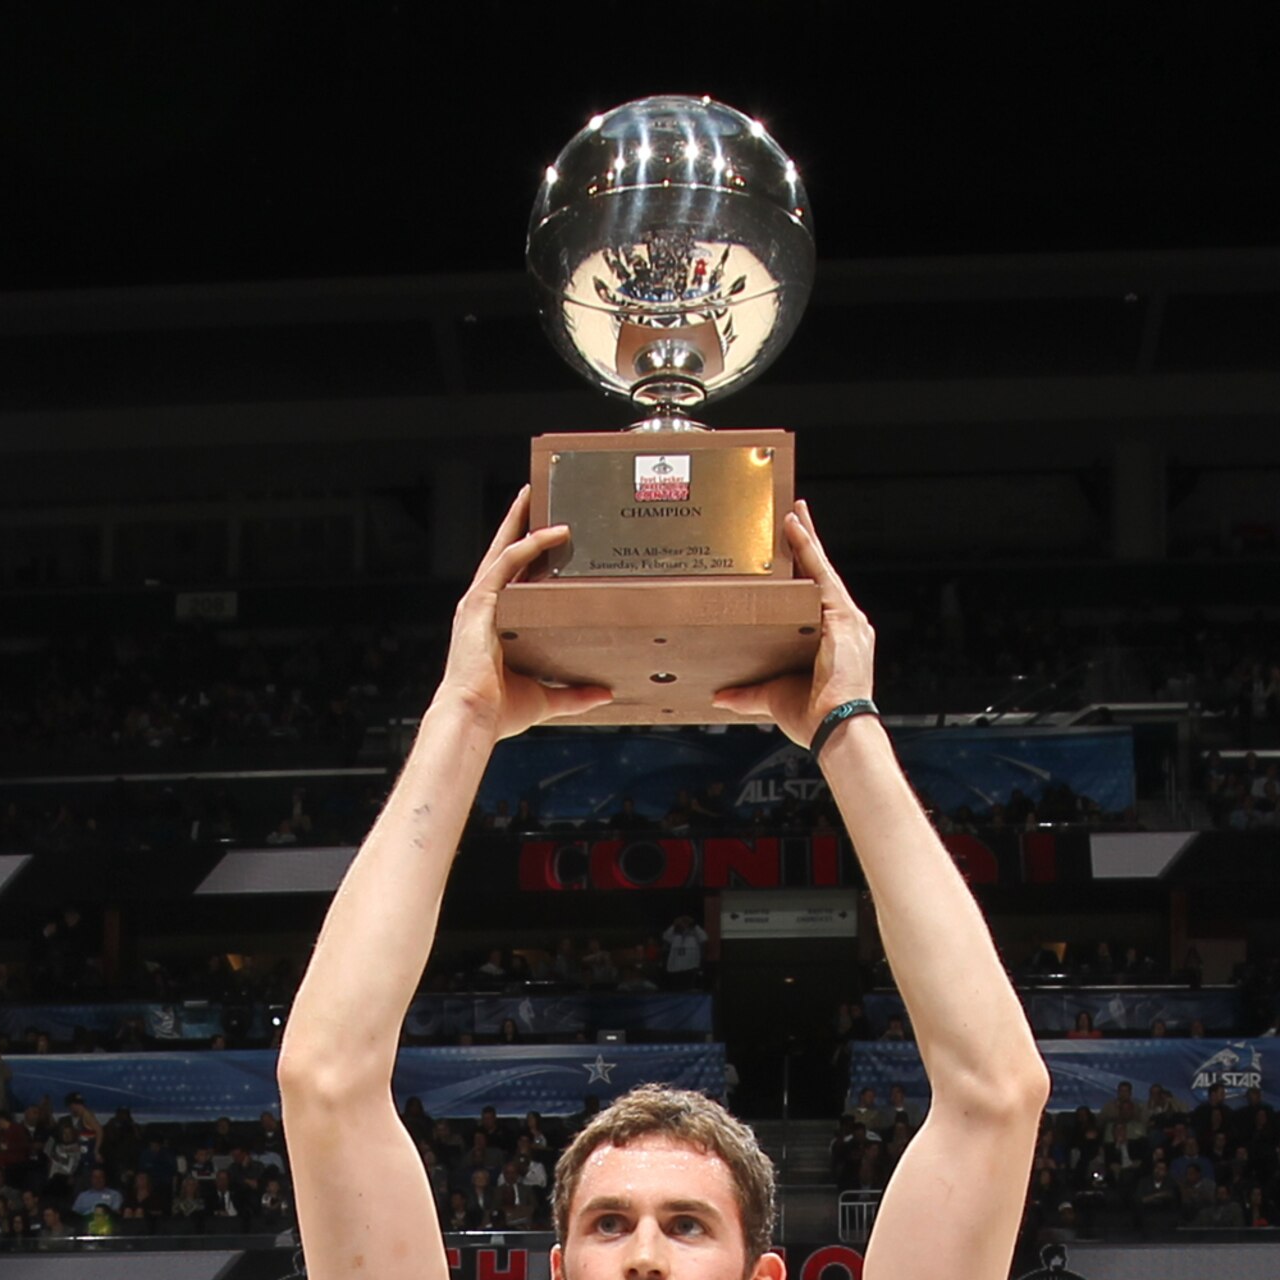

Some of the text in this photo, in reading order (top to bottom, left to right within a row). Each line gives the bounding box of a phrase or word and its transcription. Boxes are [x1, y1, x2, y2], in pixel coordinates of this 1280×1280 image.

[620, 506, 702, 518] CHAMPION
[612, 545, 711, 557] NBA All-Star 2012
[589, 558, 734, 572] Saturday, February 25, 2012
